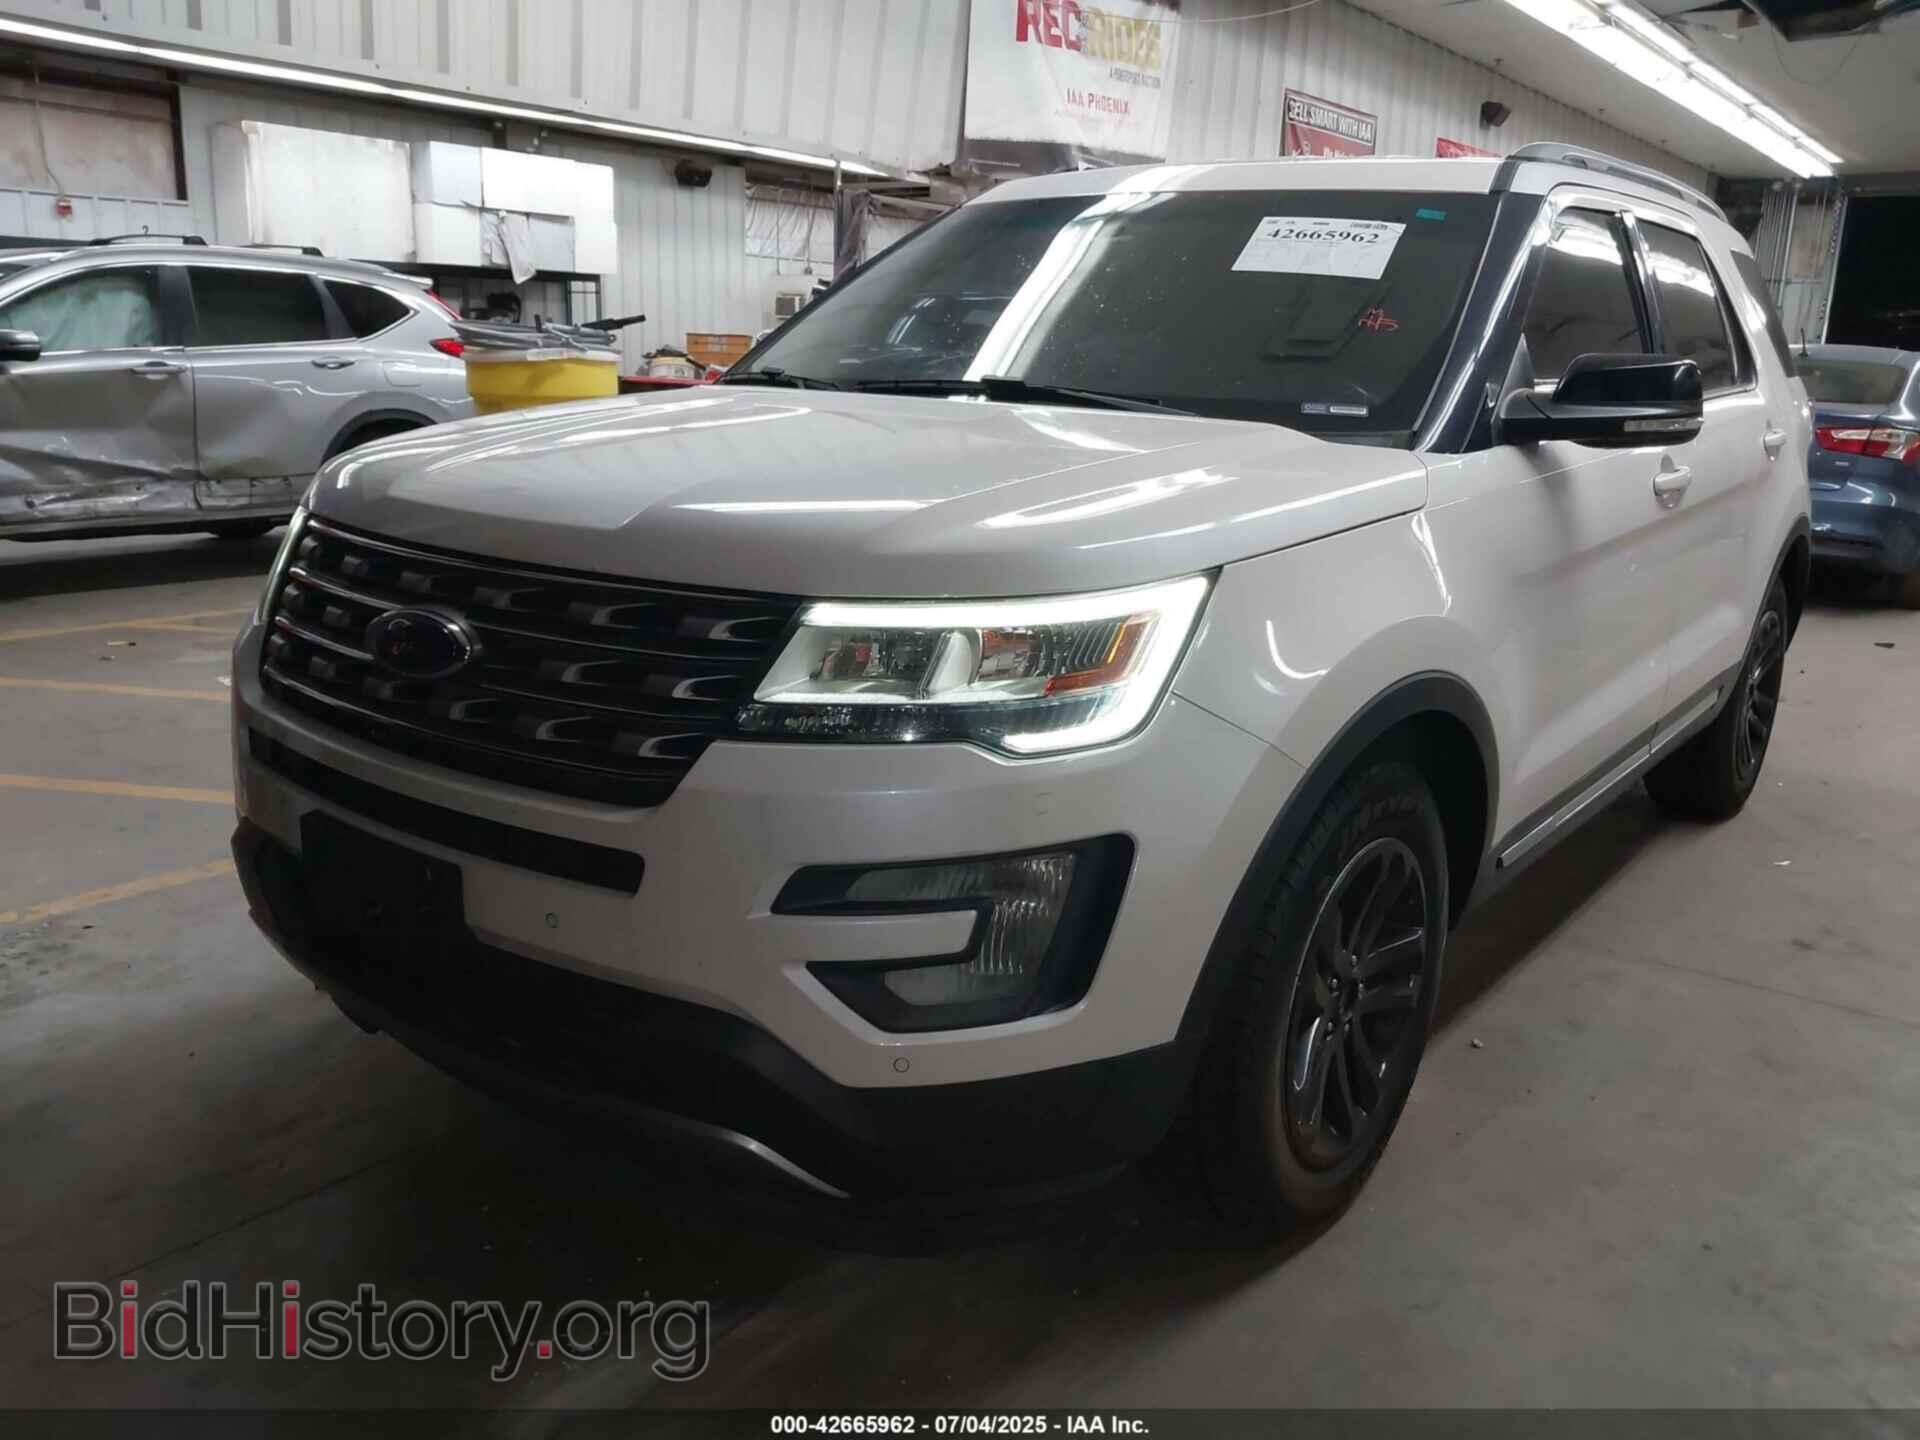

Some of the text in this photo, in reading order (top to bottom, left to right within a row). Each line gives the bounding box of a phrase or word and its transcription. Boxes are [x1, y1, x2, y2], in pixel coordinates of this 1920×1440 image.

[1066, 88, 1129, 113] IAA PHOENIX
[1288, 98, 1372, 142] SELL SMART WITH IAA
[1267, 228, 1379, 244] 42665962
